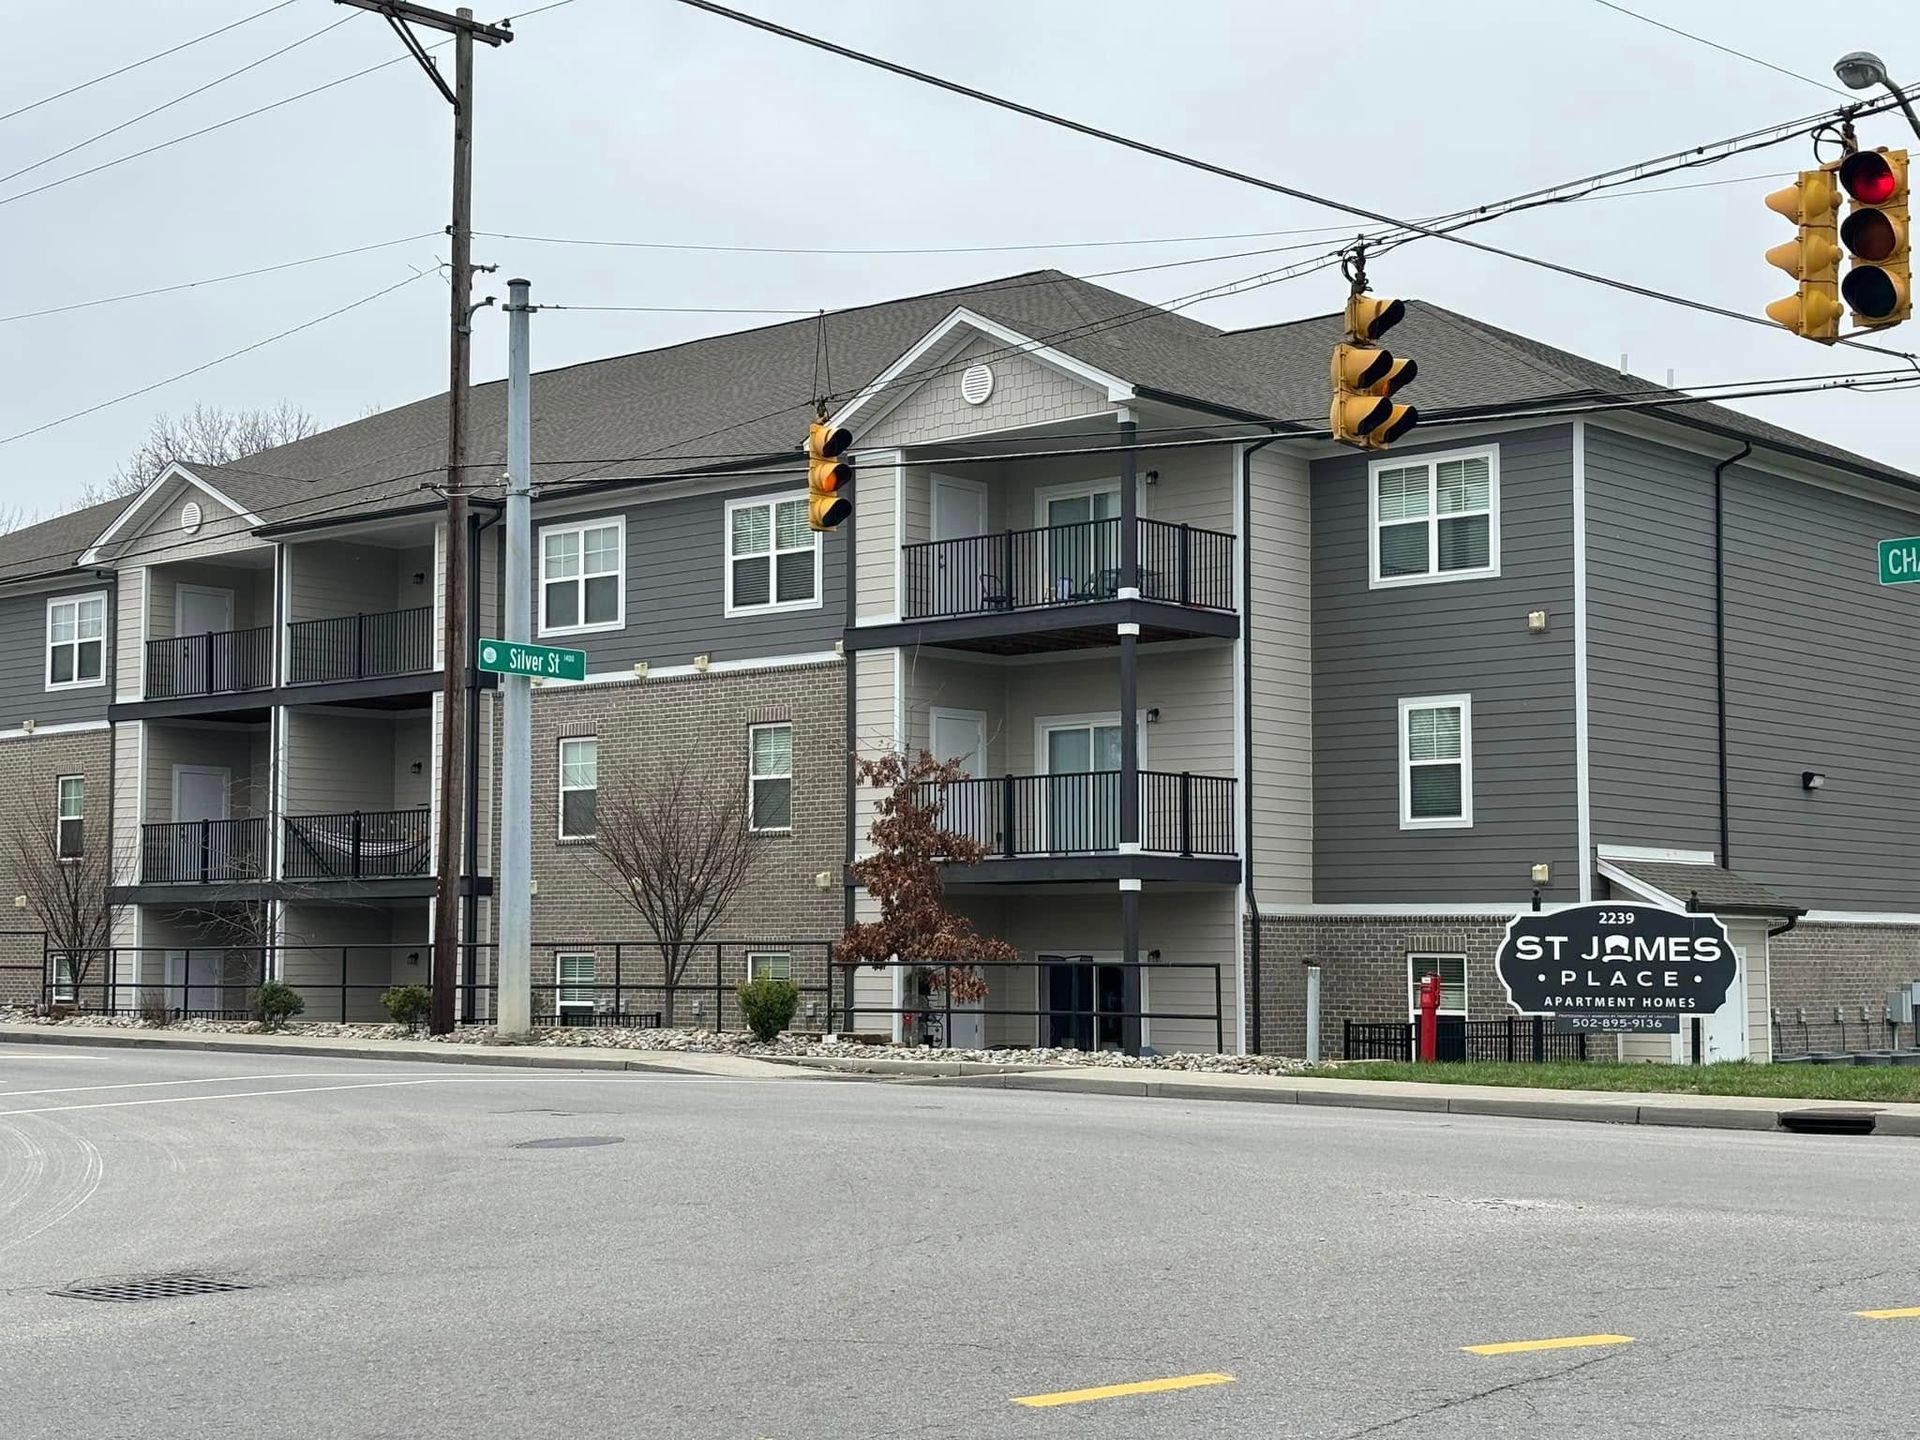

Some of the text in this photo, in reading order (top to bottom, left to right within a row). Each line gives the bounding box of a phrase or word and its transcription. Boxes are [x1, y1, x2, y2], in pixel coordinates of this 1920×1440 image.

[1888, 547, 1920, 575] CH
[509, 647, 543, 671] Silver
[547, 652, 560, 674] St
[1598, 912, 1635, 925] 2239
[1515, 936, 1568, 961] ST
[1561, 970, 1679, 987] PLACE
[1544, 996, 1696, 1008] APARTMENT HOMES
[1572, 1018, 1662, 1028] 502-895-9136
